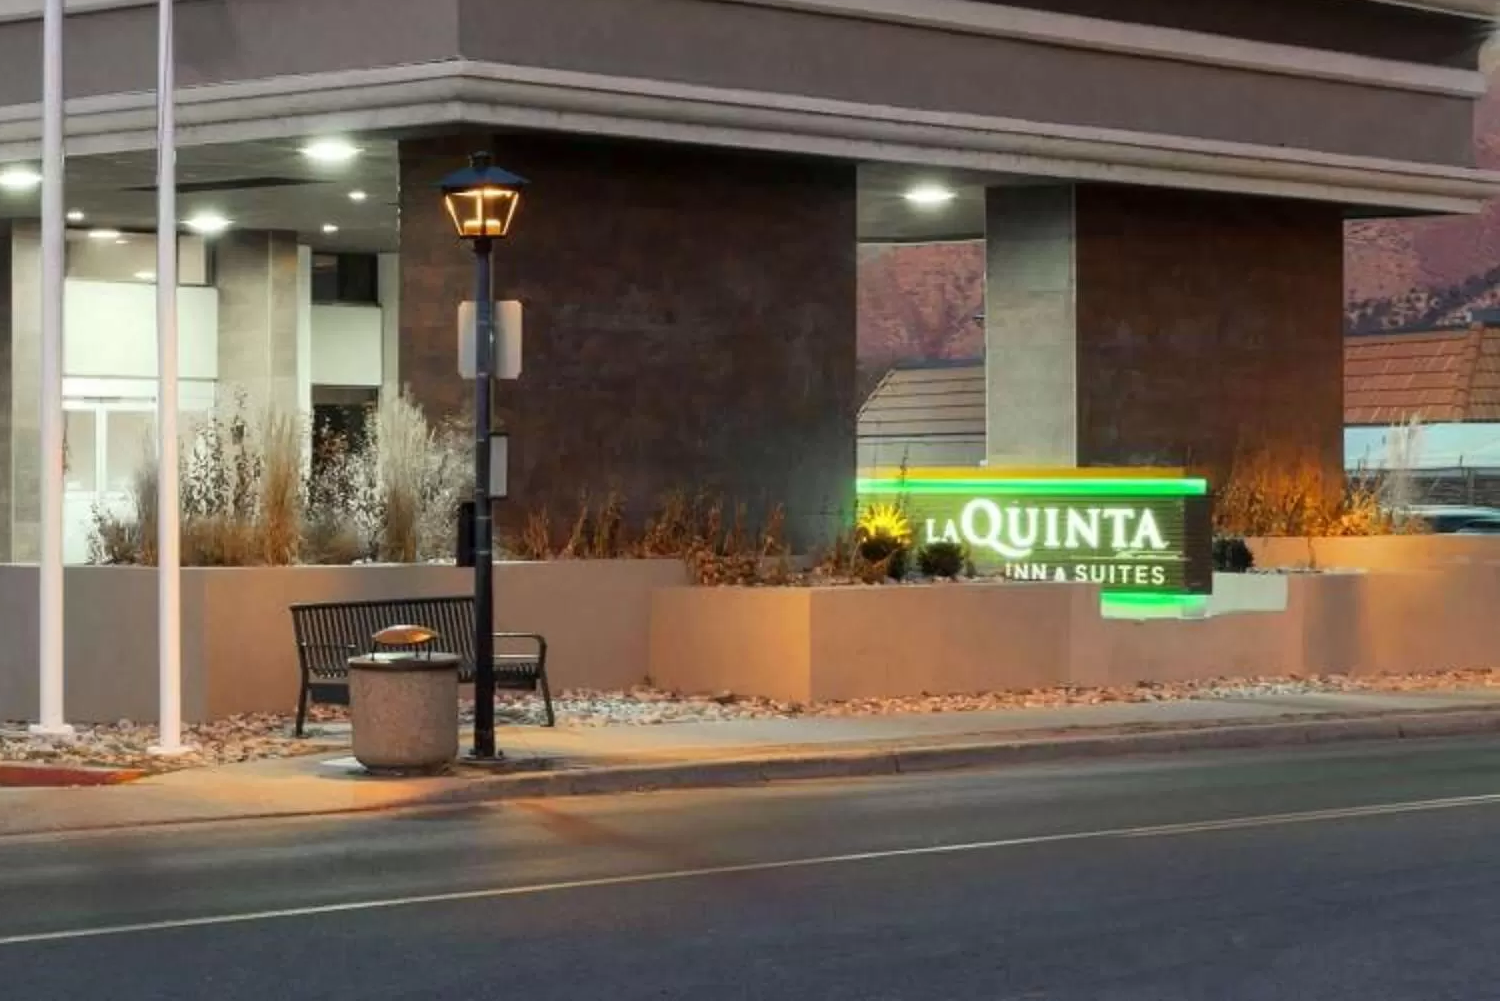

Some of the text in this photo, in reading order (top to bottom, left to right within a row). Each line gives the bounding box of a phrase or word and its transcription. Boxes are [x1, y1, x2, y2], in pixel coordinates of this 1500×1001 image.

[925, 498, 1171, 557] LA QUINTA
[1075, 564, 1165, 585] SUITES
